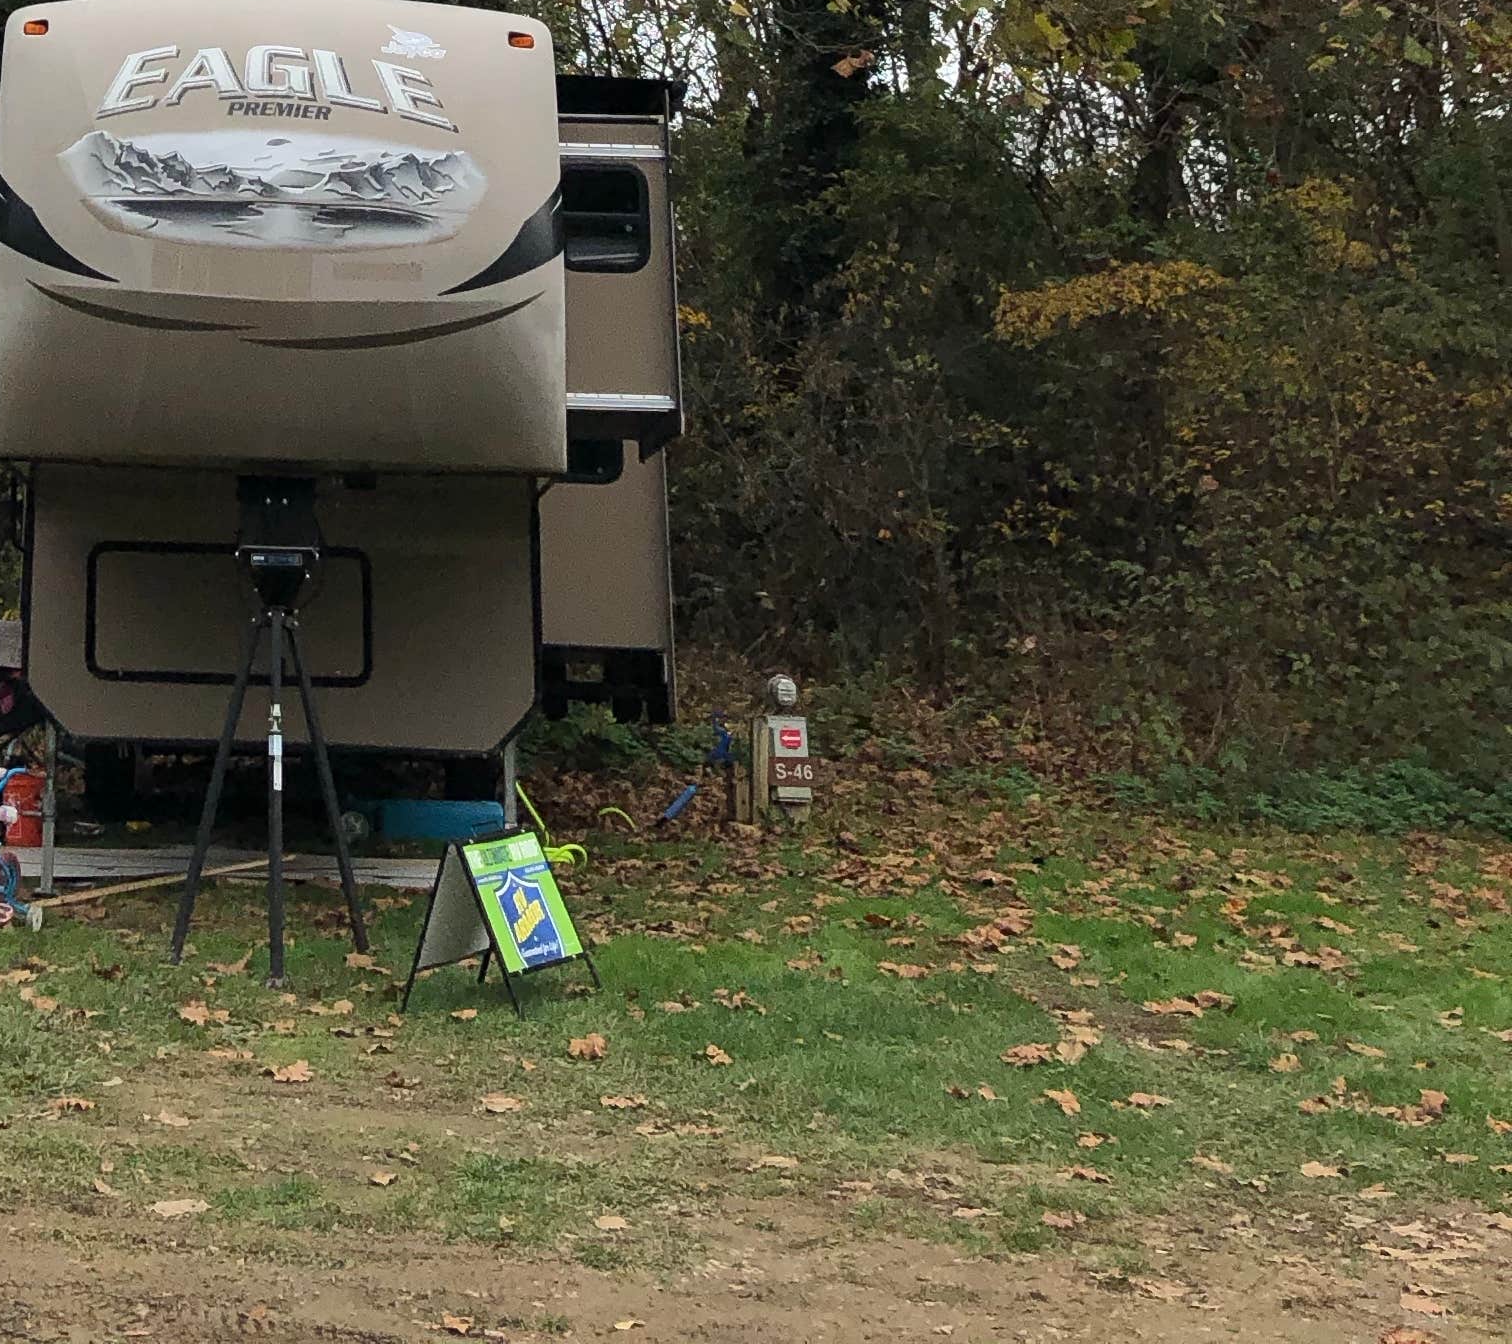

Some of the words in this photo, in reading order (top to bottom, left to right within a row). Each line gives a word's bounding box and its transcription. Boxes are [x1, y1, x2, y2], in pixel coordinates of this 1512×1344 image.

[96, 45, 459, 133] EAGLE
[227, 101, 332, 120] PREMIER
[775, 763, 813, 780] S-46
